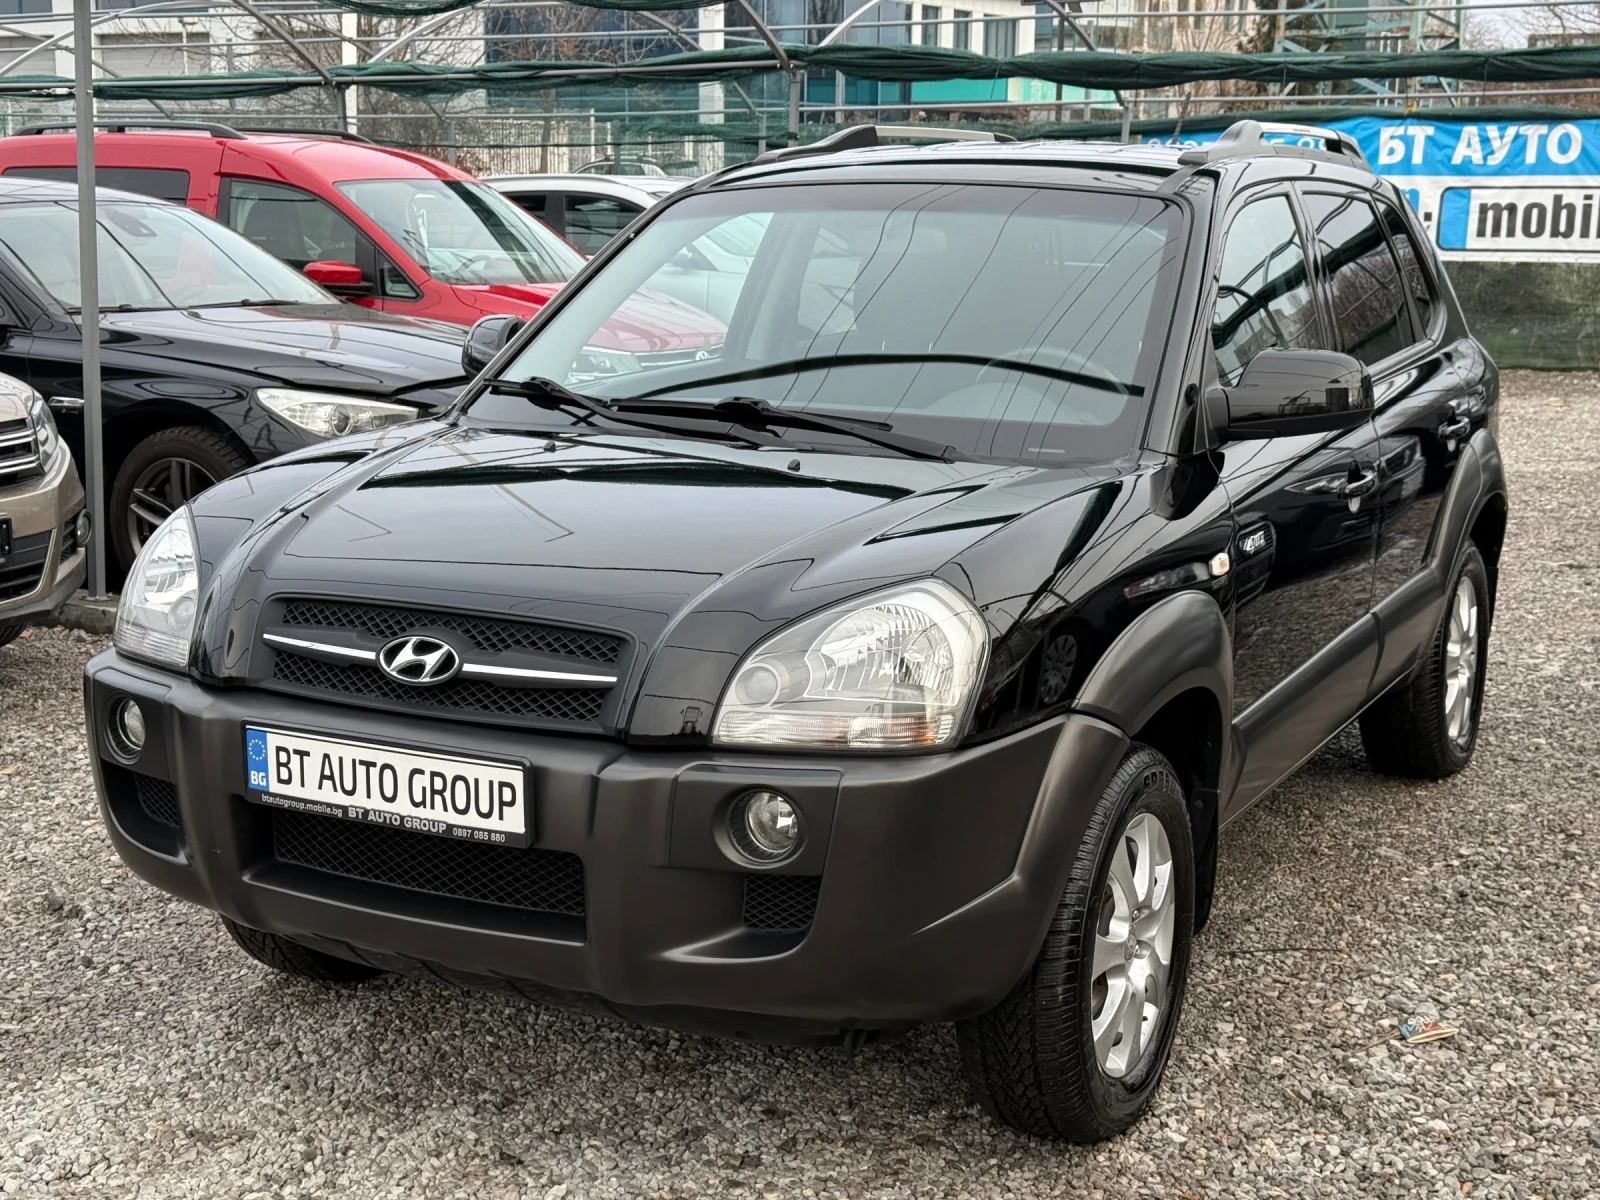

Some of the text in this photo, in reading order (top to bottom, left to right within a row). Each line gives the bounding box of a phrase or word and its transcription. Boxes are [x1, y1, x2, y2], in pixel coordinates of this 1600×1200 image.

[1378, 123, 1582, 165] БТ АУТО
[250, 771, 267, 786] BG
[275, 745, 516, 821] BT AUTO GROUP
[261, 794, 506, 843] btautogroup.mobile.bg BT AUTO GROUP 0897 085 880
